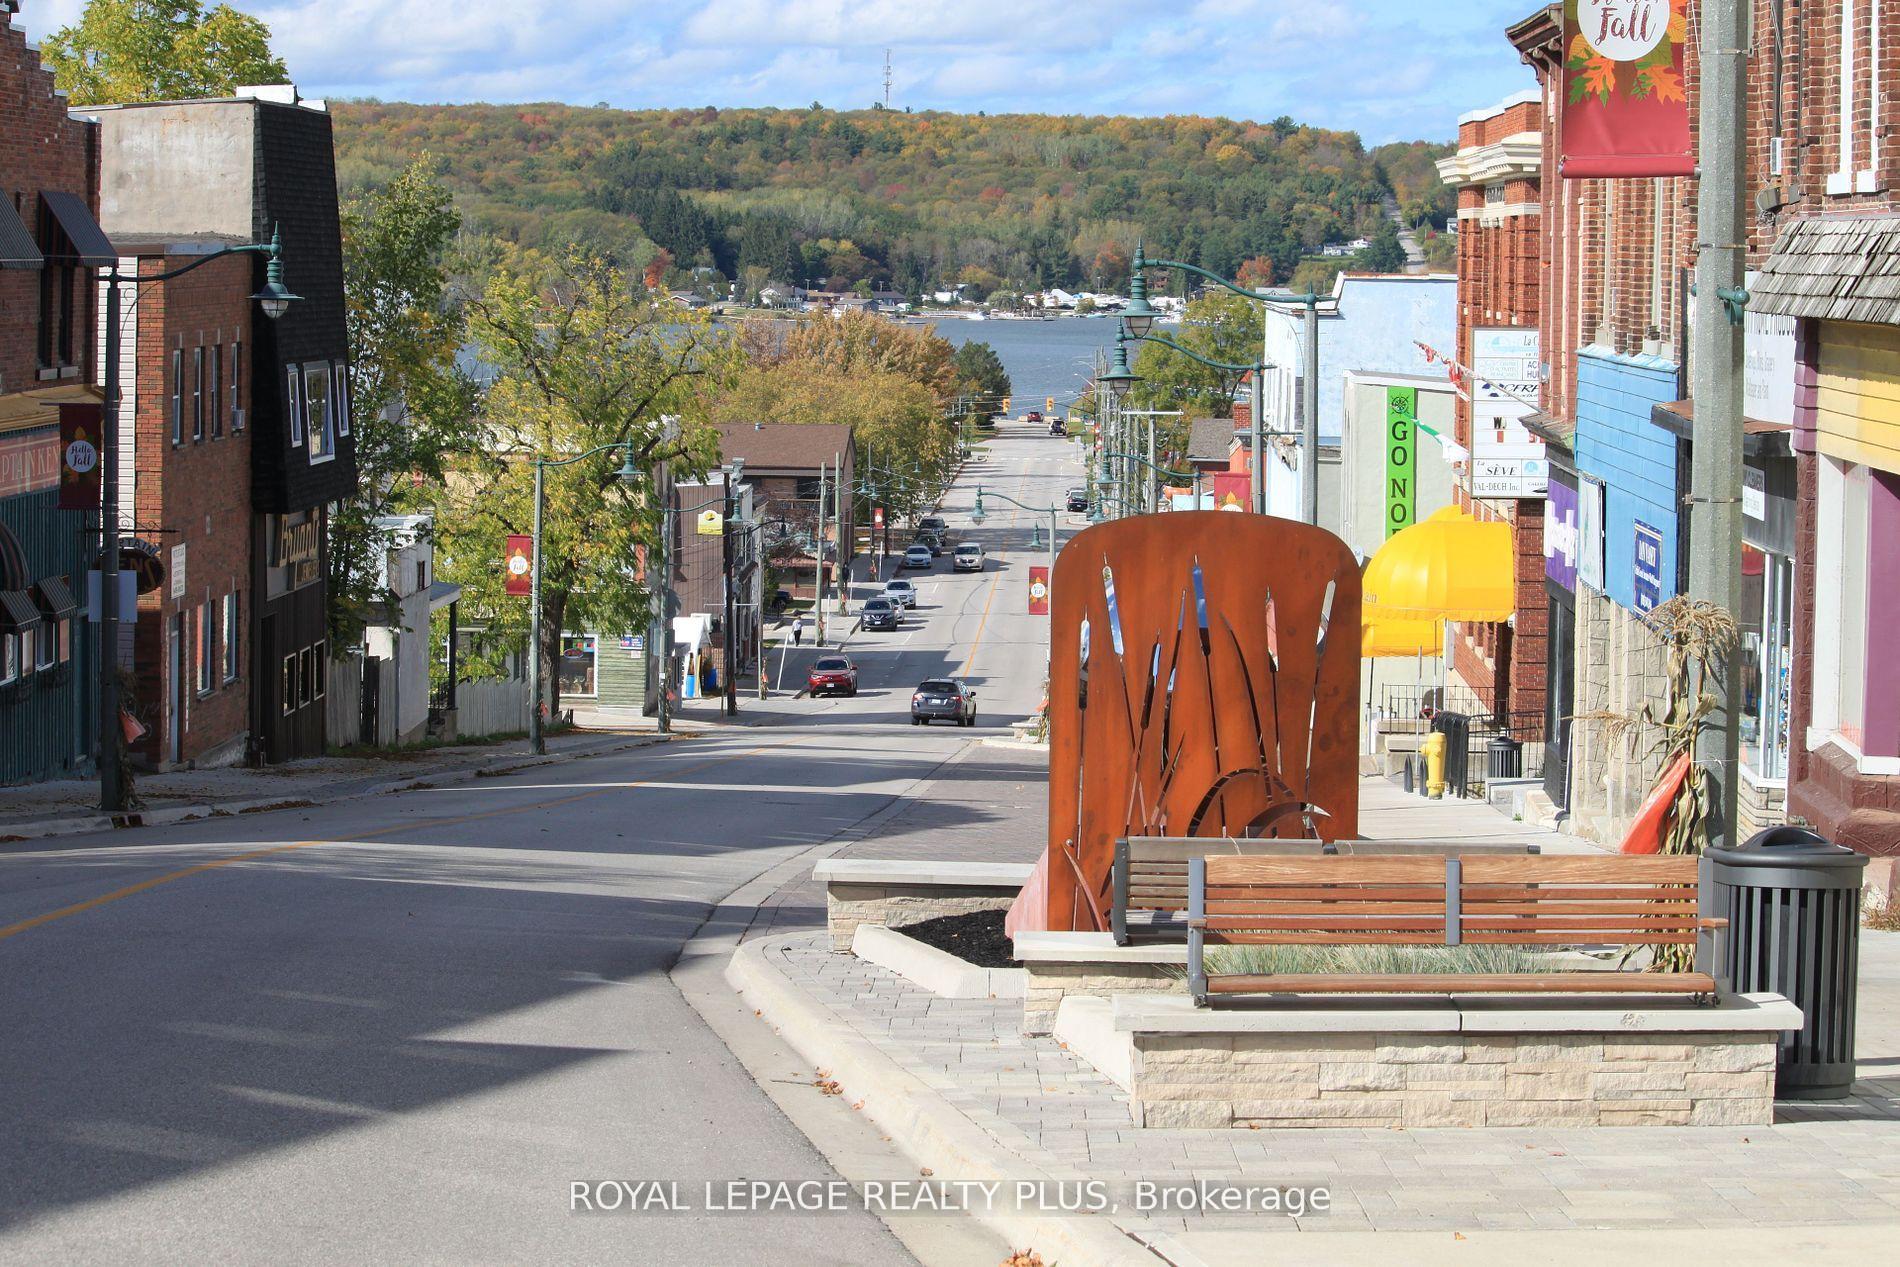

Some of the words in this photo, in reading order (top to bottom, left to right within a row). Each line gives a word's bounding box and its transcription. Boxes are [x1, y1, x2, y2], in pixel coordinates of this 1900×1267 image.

[1594, 4, 1657, 46] Fall
[1486, 463, 1518, 476] SÈVE
[1390, 478, 1408, 536] NO
